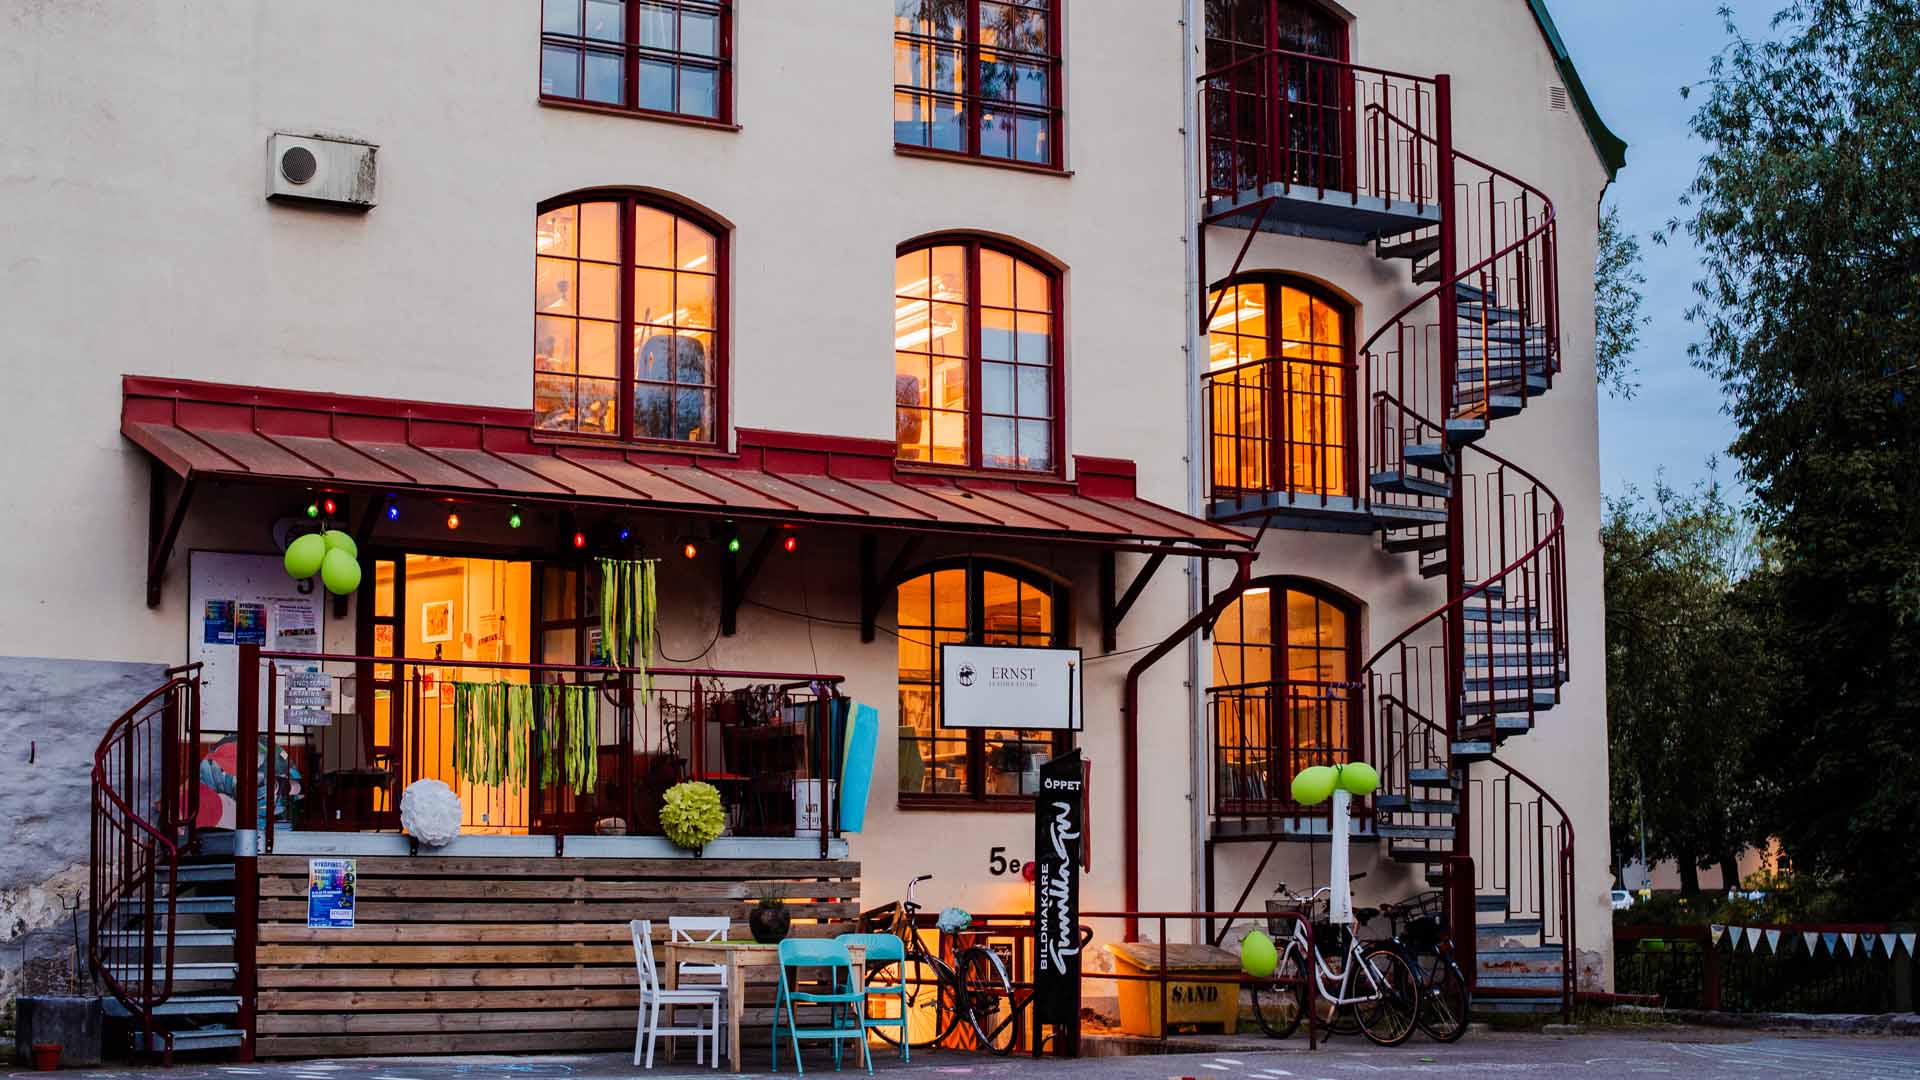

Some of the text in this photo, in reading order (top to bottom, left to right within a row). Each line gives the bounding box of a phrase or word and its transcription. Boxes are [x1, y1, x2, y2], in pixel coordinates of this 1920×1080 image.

[991, 666, 1037, 681] ERNST
[1044, 777, 1081, 791] ÖPPET
[990, 846, 1021, 876] 5e
[1040, 863, 1049, 970] BILDMAKARE
[1171, 985, 1218, 1003] SAND
